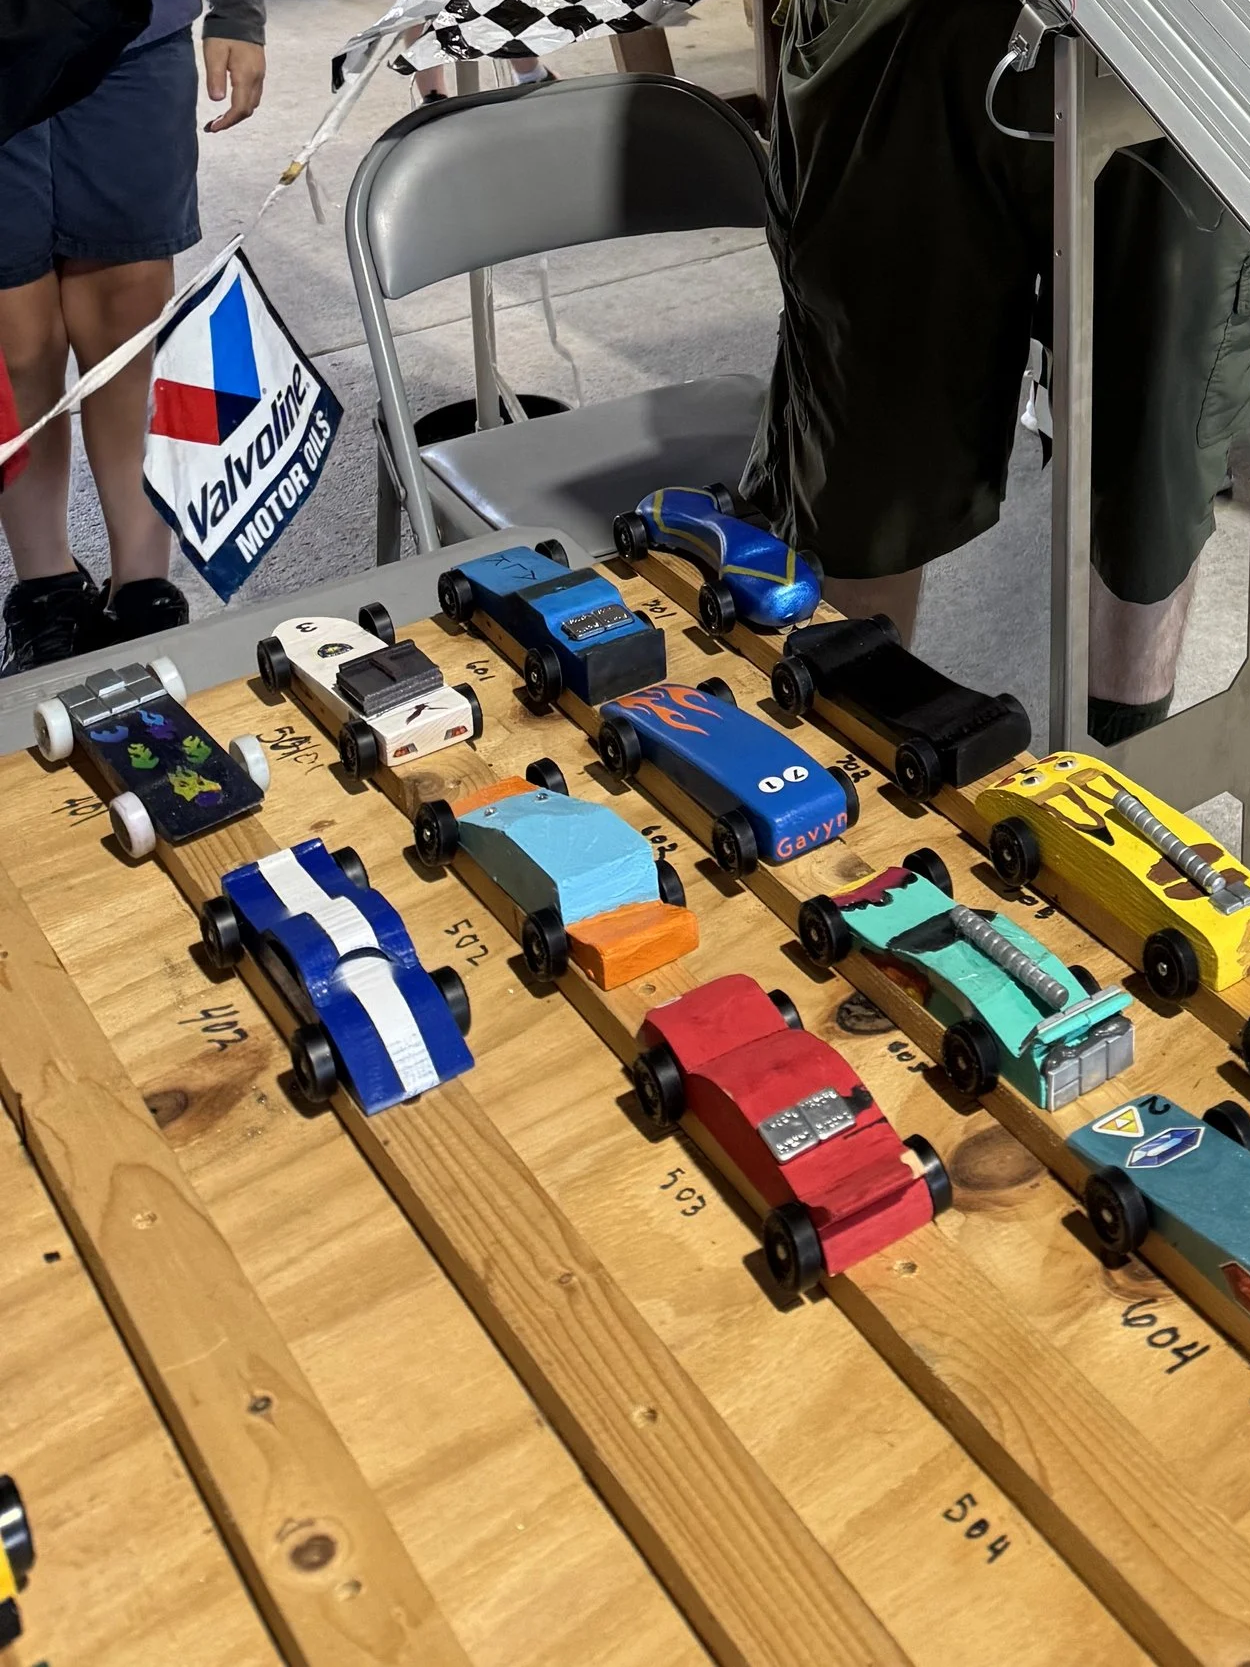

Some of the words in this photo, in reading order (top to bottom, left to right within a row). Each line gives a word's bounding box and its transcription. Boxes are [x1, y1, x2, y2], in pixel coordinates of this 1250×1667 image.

[187, 362, 308, 544] Valvoline
[234, 462, 310, 564] MOTOR
[303, 409, 332, 473] OILS
[295, 621, 317, 633] 3
[465, 659, 496, 682] 601
[836, 754, 872, 783] 702
[641, 825, 678, 860] 602
[776, 812, 848, 859] Gavyn
[443, 918, 489, 967] 502
[177, 1003, 249, 1052] 402
[659, 1167, 707, 1217] 503
[1121, 1298, 1212, 1375] 604
[942, 1492, 1012, 1565] 504
